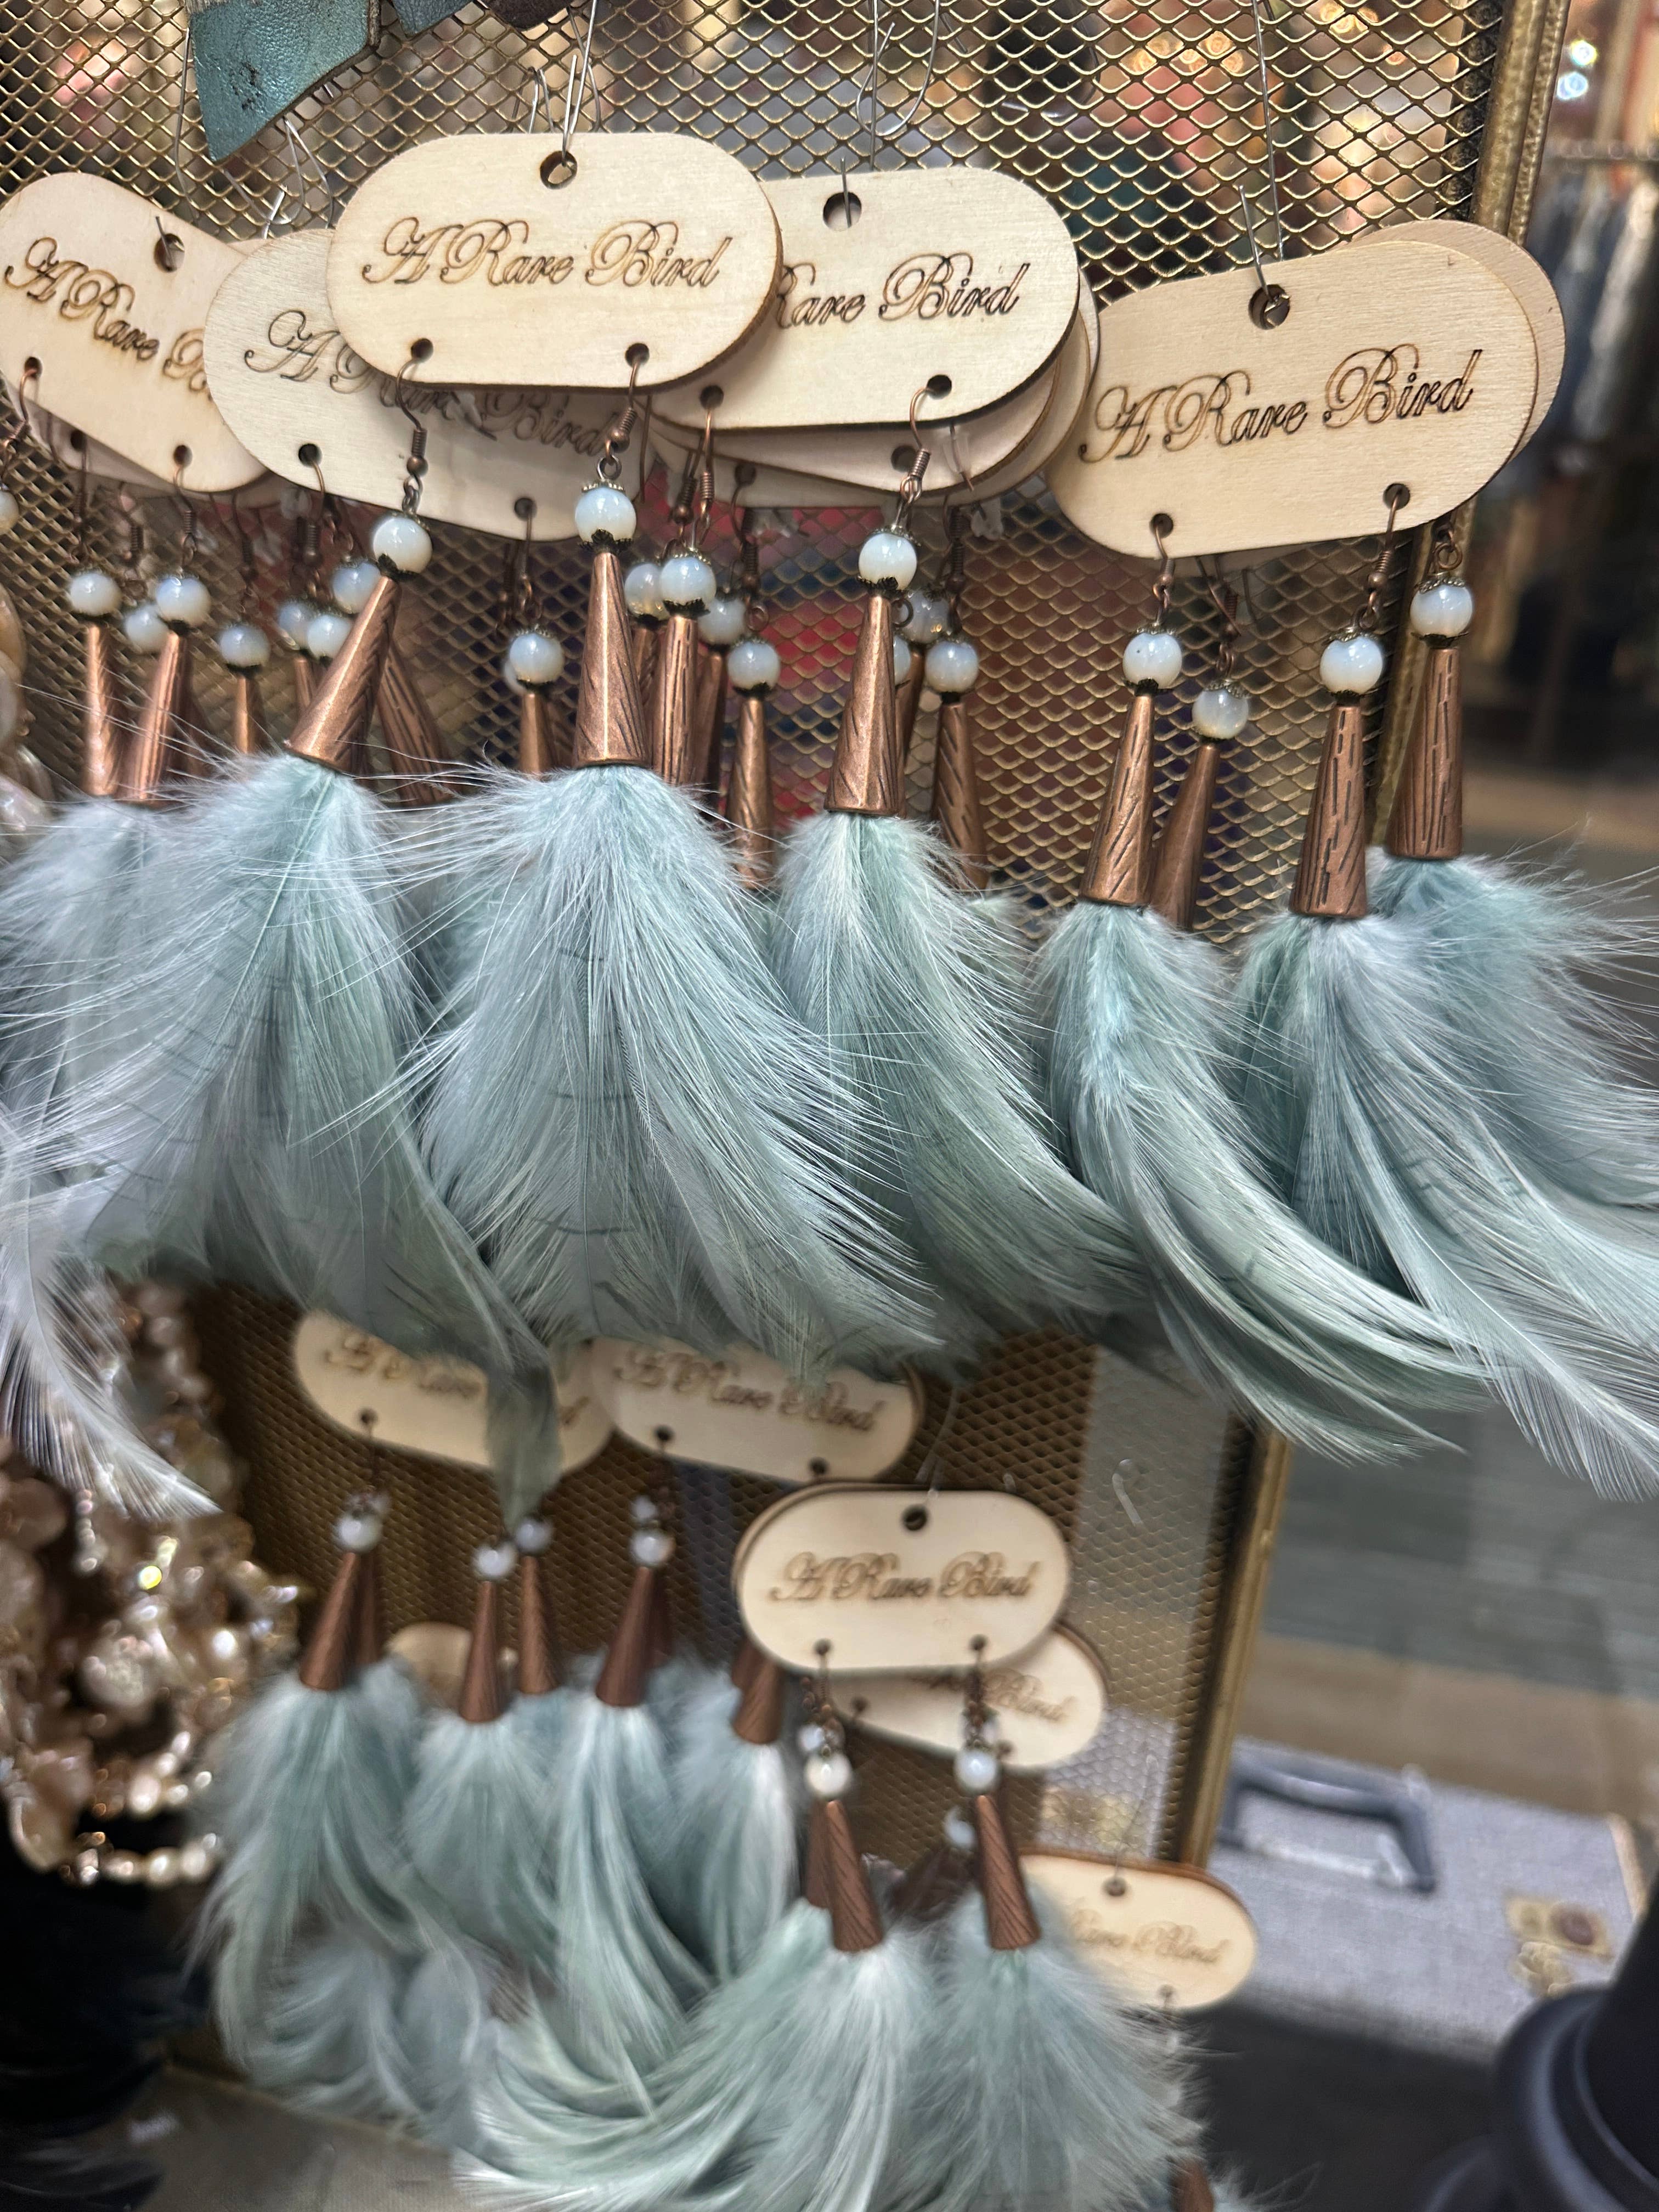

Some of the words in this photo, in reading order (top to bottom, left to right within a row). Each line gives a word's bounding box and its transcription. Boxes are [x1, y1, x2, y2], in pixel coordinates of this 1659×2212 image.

[361, 216, 464, 285] A
[440, 219, 574, 287] Rare
[585, 219, 732, 287] Bird
[878, 252, 1031, 321] Bird
[4, 236, 89, 302] A
[60, 269, 160, 362] Rare
[244, 309, 340, 382] A
[1078, 386, 1177, 464] A
[1163, 370, 1308, 449] Rare
[1322, 343, 1483, 429] Bird
[833, 1553, 935, 1602] Rare
[937, 1550, 1041, 1600] Bird
